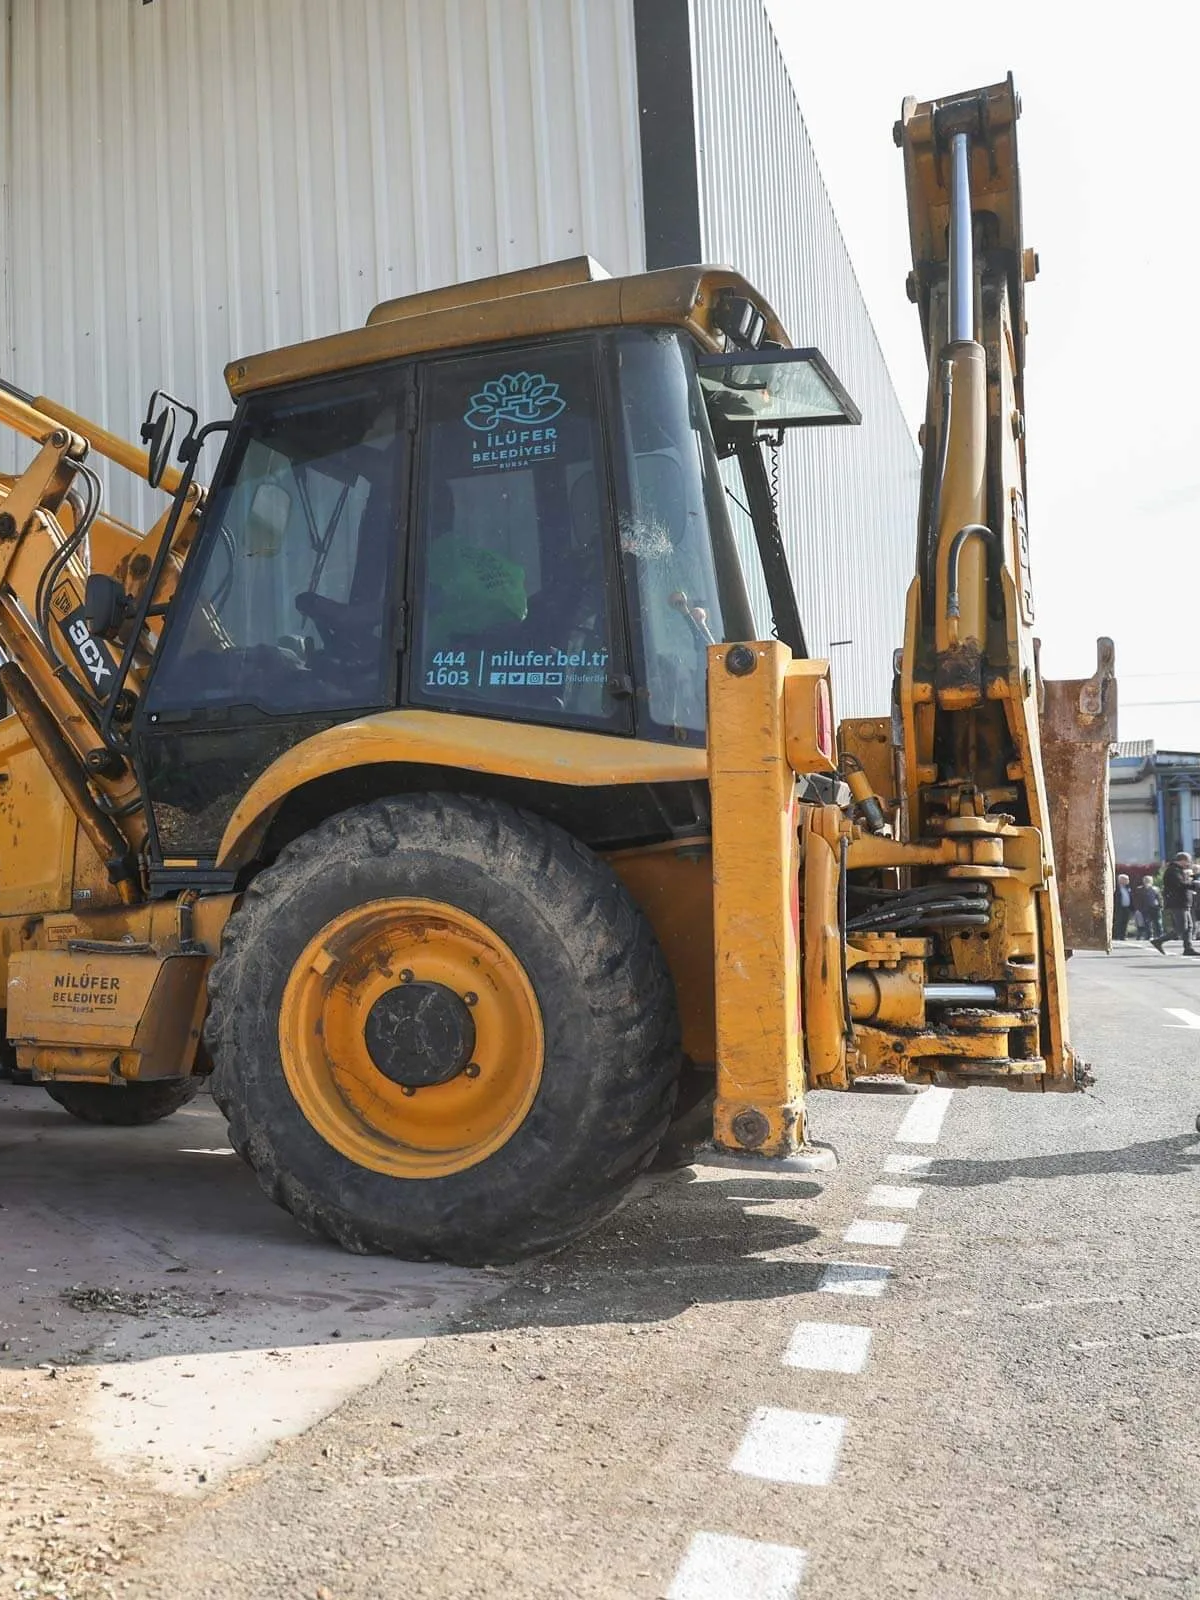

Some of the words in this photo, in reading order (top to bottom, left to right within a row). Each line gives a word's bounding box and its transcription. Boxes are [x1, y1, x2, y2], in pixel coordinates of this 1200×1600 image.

[473, 427, 557, 449] İLÜFER
[472, 440, 556, 463] BELEDİYESİ
[500, 460, 529, 469] BURSA
[68, 619, 112, 686] 3CX
[432, 651, 466, 667] 444
[491, 650, 608, 666] nilufer.bel.tr
[425, 667, 470, 686] 1603
[54, 972, 120, 990] NİLÜFER
[53, 991, 118, 1005] BELEDİYESİ
